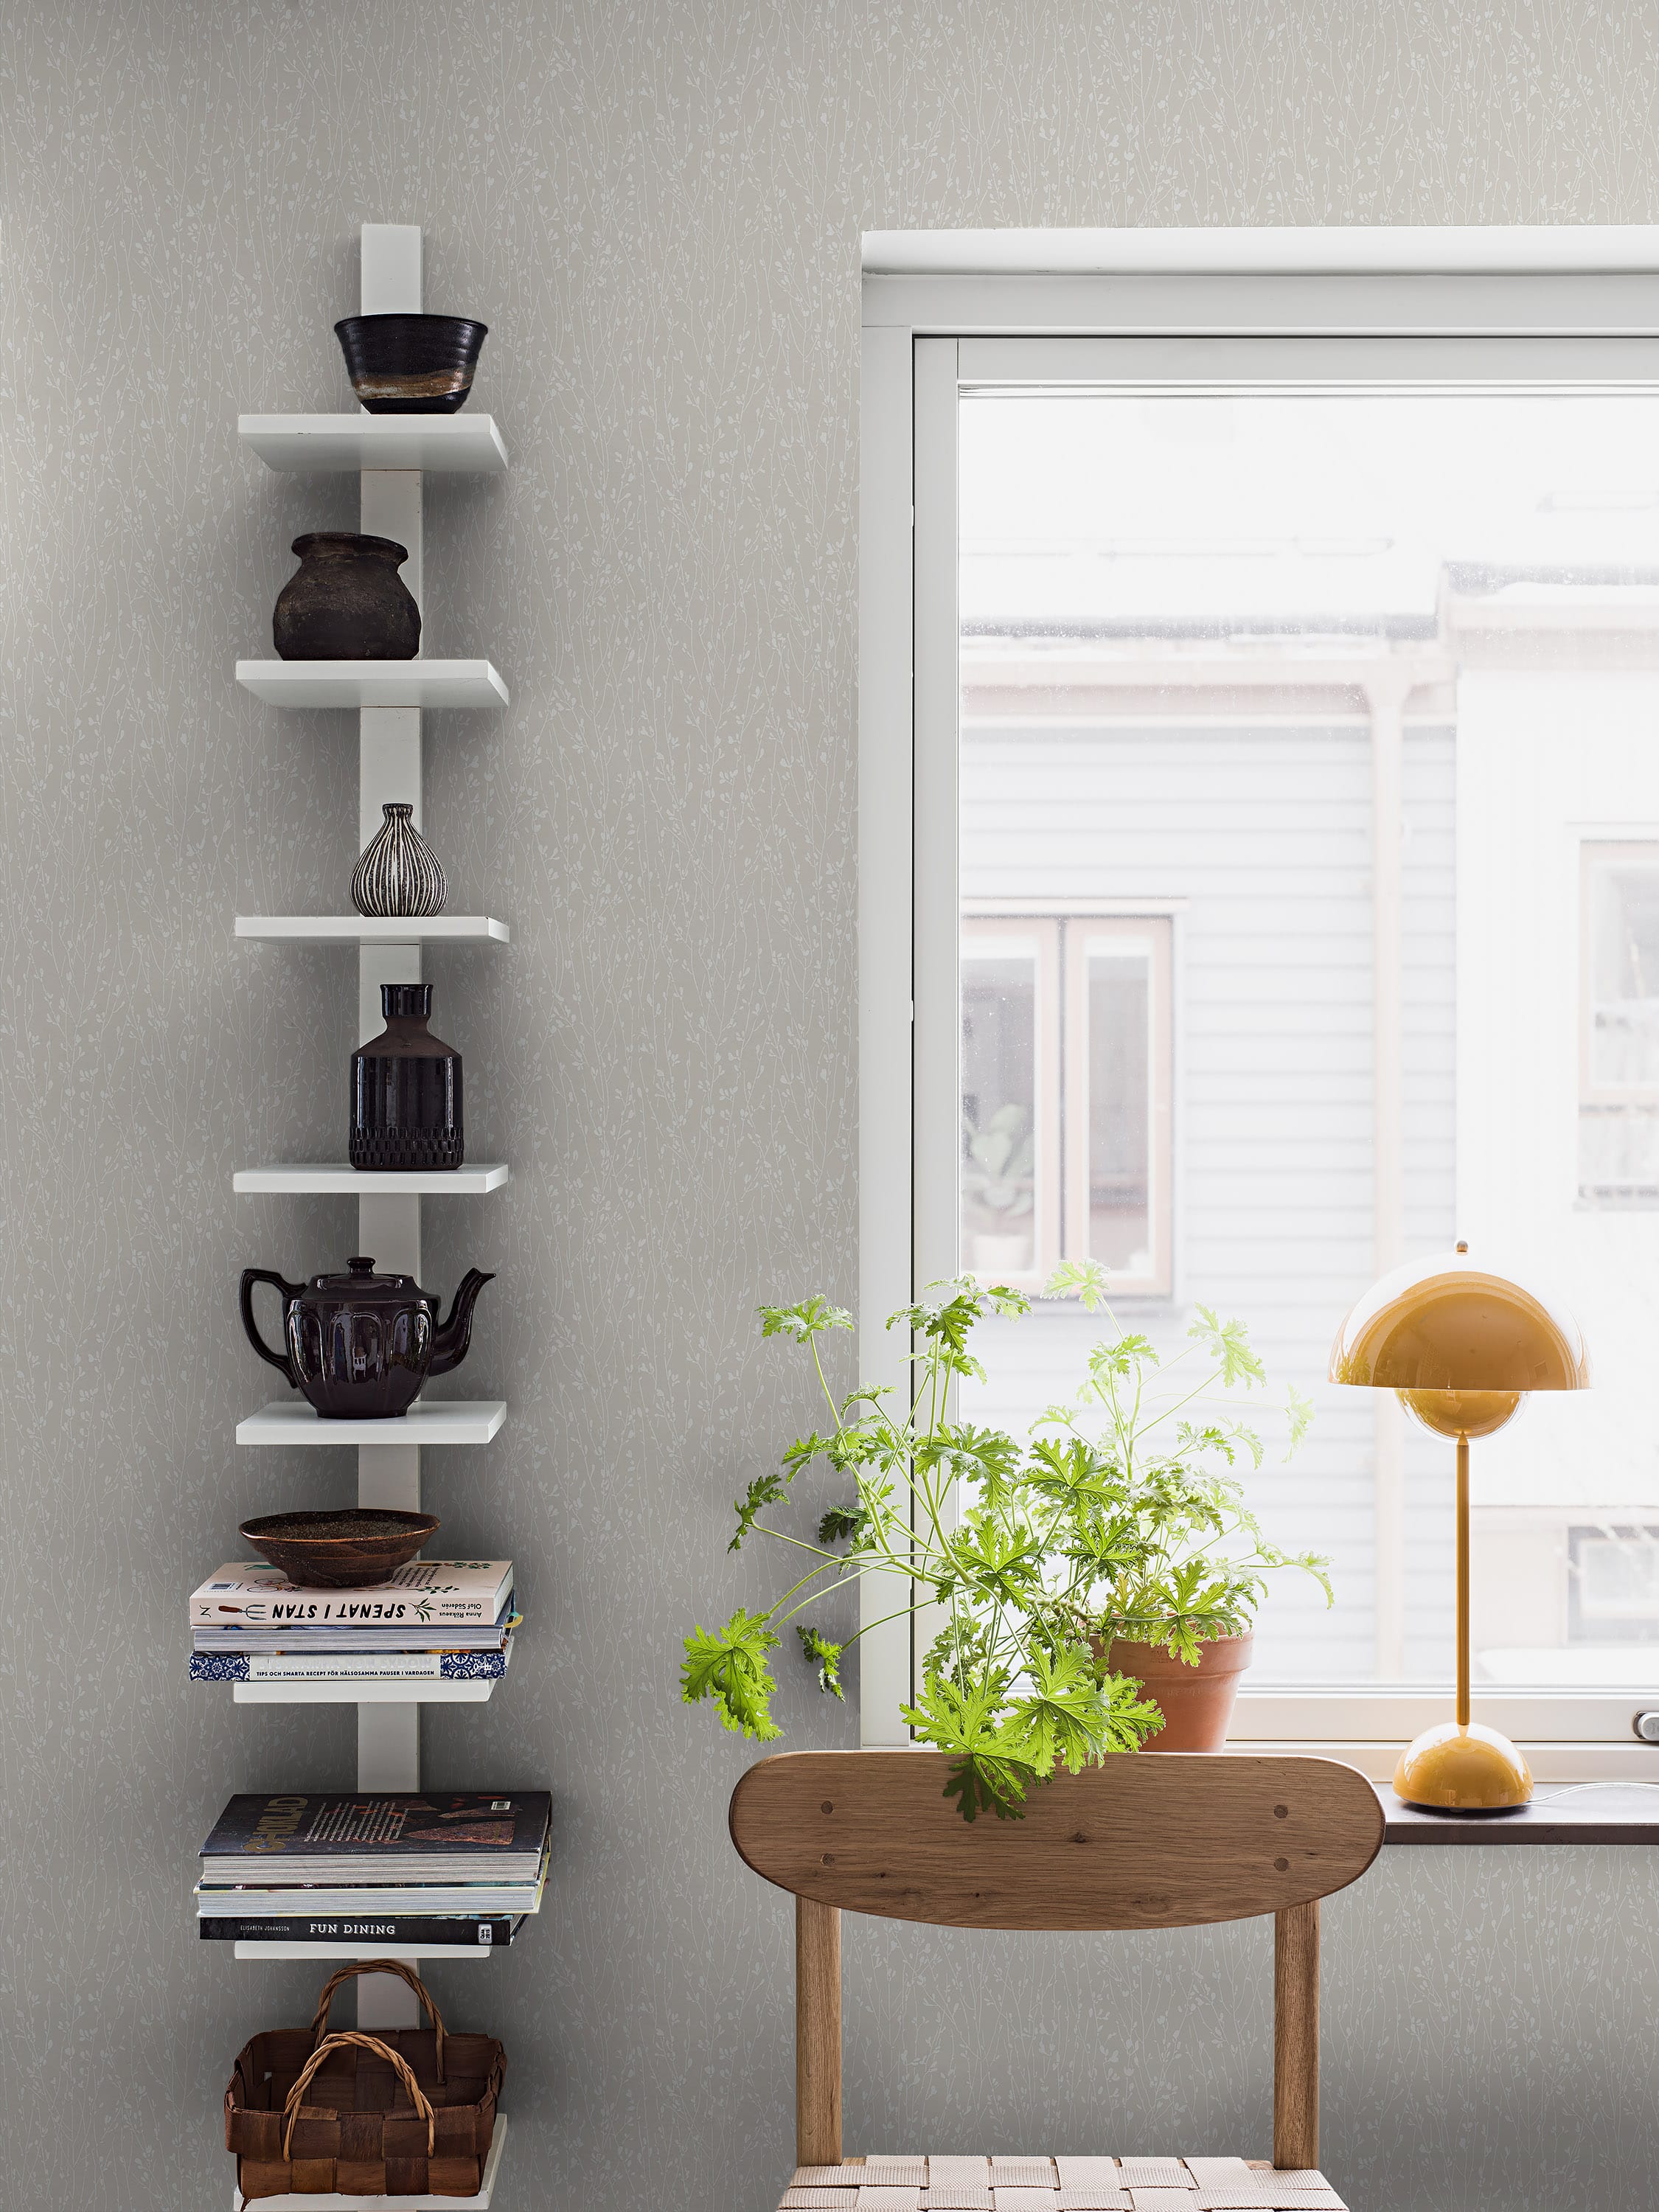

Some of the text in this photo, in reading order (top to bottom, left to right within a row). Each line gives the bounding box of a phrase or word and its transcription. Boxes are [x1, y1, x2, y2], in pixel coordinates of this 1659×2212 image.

[272, 1603, 406, 1619] SPENAT I STAN
[380, 1656, 432, 1669] SYDOW
[243, 1797, 308, 1852] CHOKLAD
[309, 1923, 396, 1935] FUN DINING
